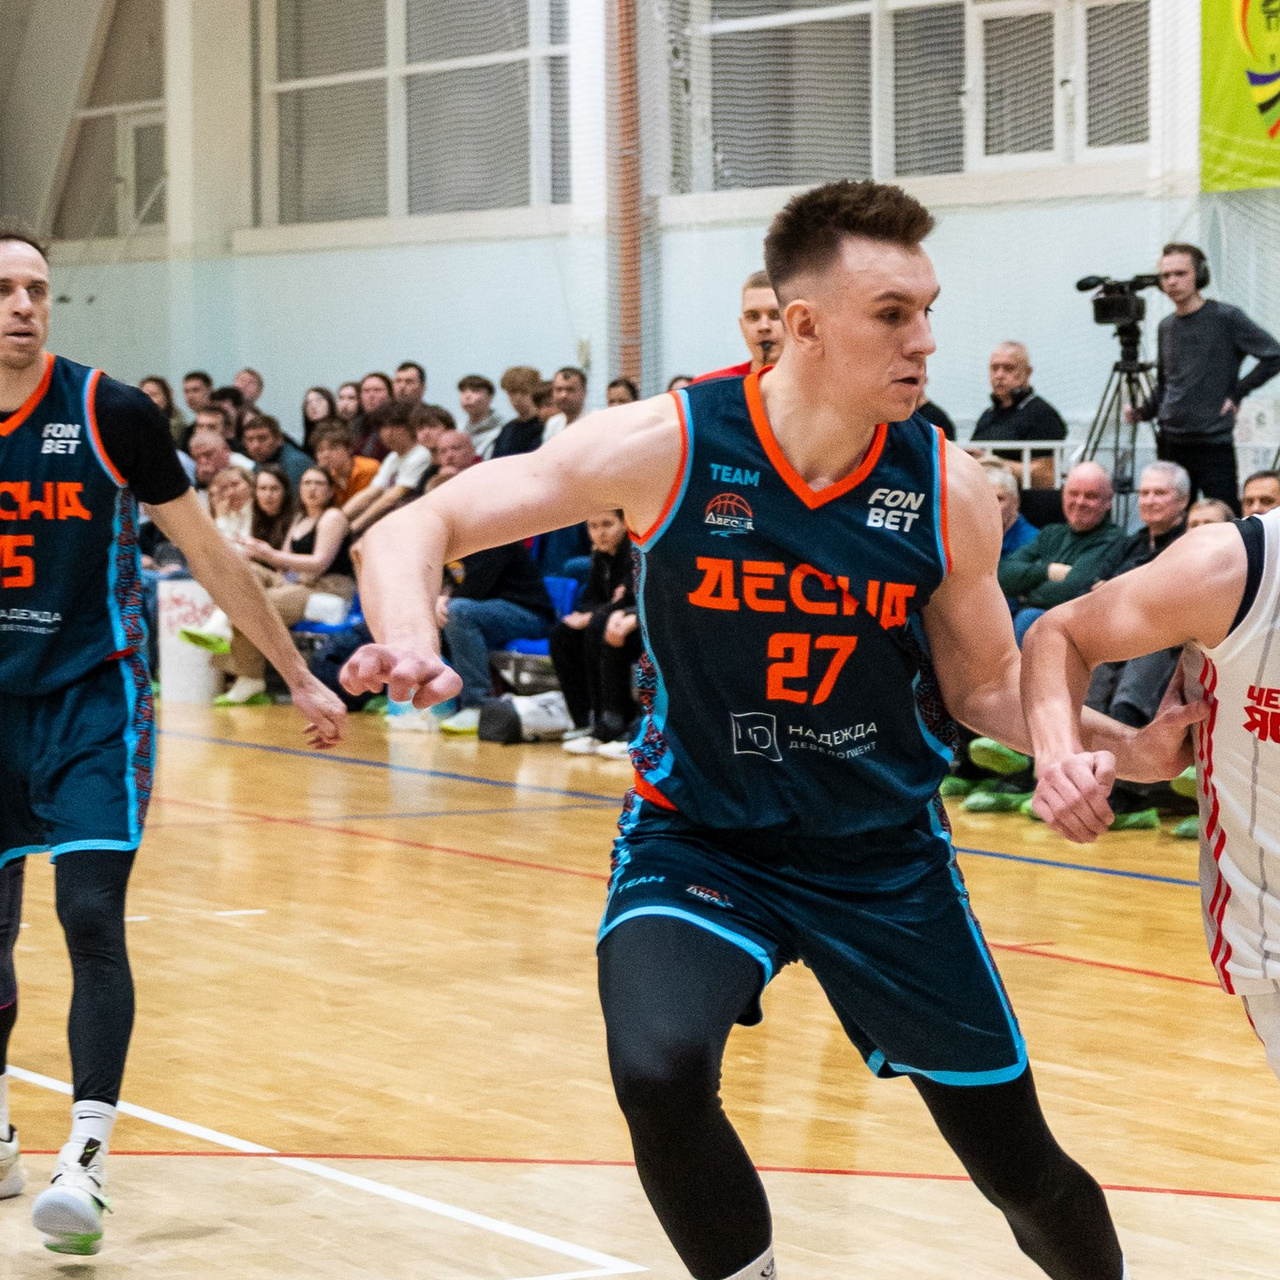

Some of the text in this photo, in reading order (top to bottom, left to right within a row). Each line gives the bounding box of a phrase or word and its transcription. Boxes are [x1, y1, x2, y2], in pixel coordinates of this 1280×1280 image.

[42, 423, 81, 439] FON
[41, 439, 82, 455] BET
[710, 463, 761, 487] TEAM
[868, 488, 925, 512] FON
[866, 508, 920, 533] BET
[688, 557, 917, 631] ДЕСНА
[765, 631, 859, 707] 27
[788, 722, 879, 748] НАДЕЖДА
[618, 875, 667, 894] TEAM
